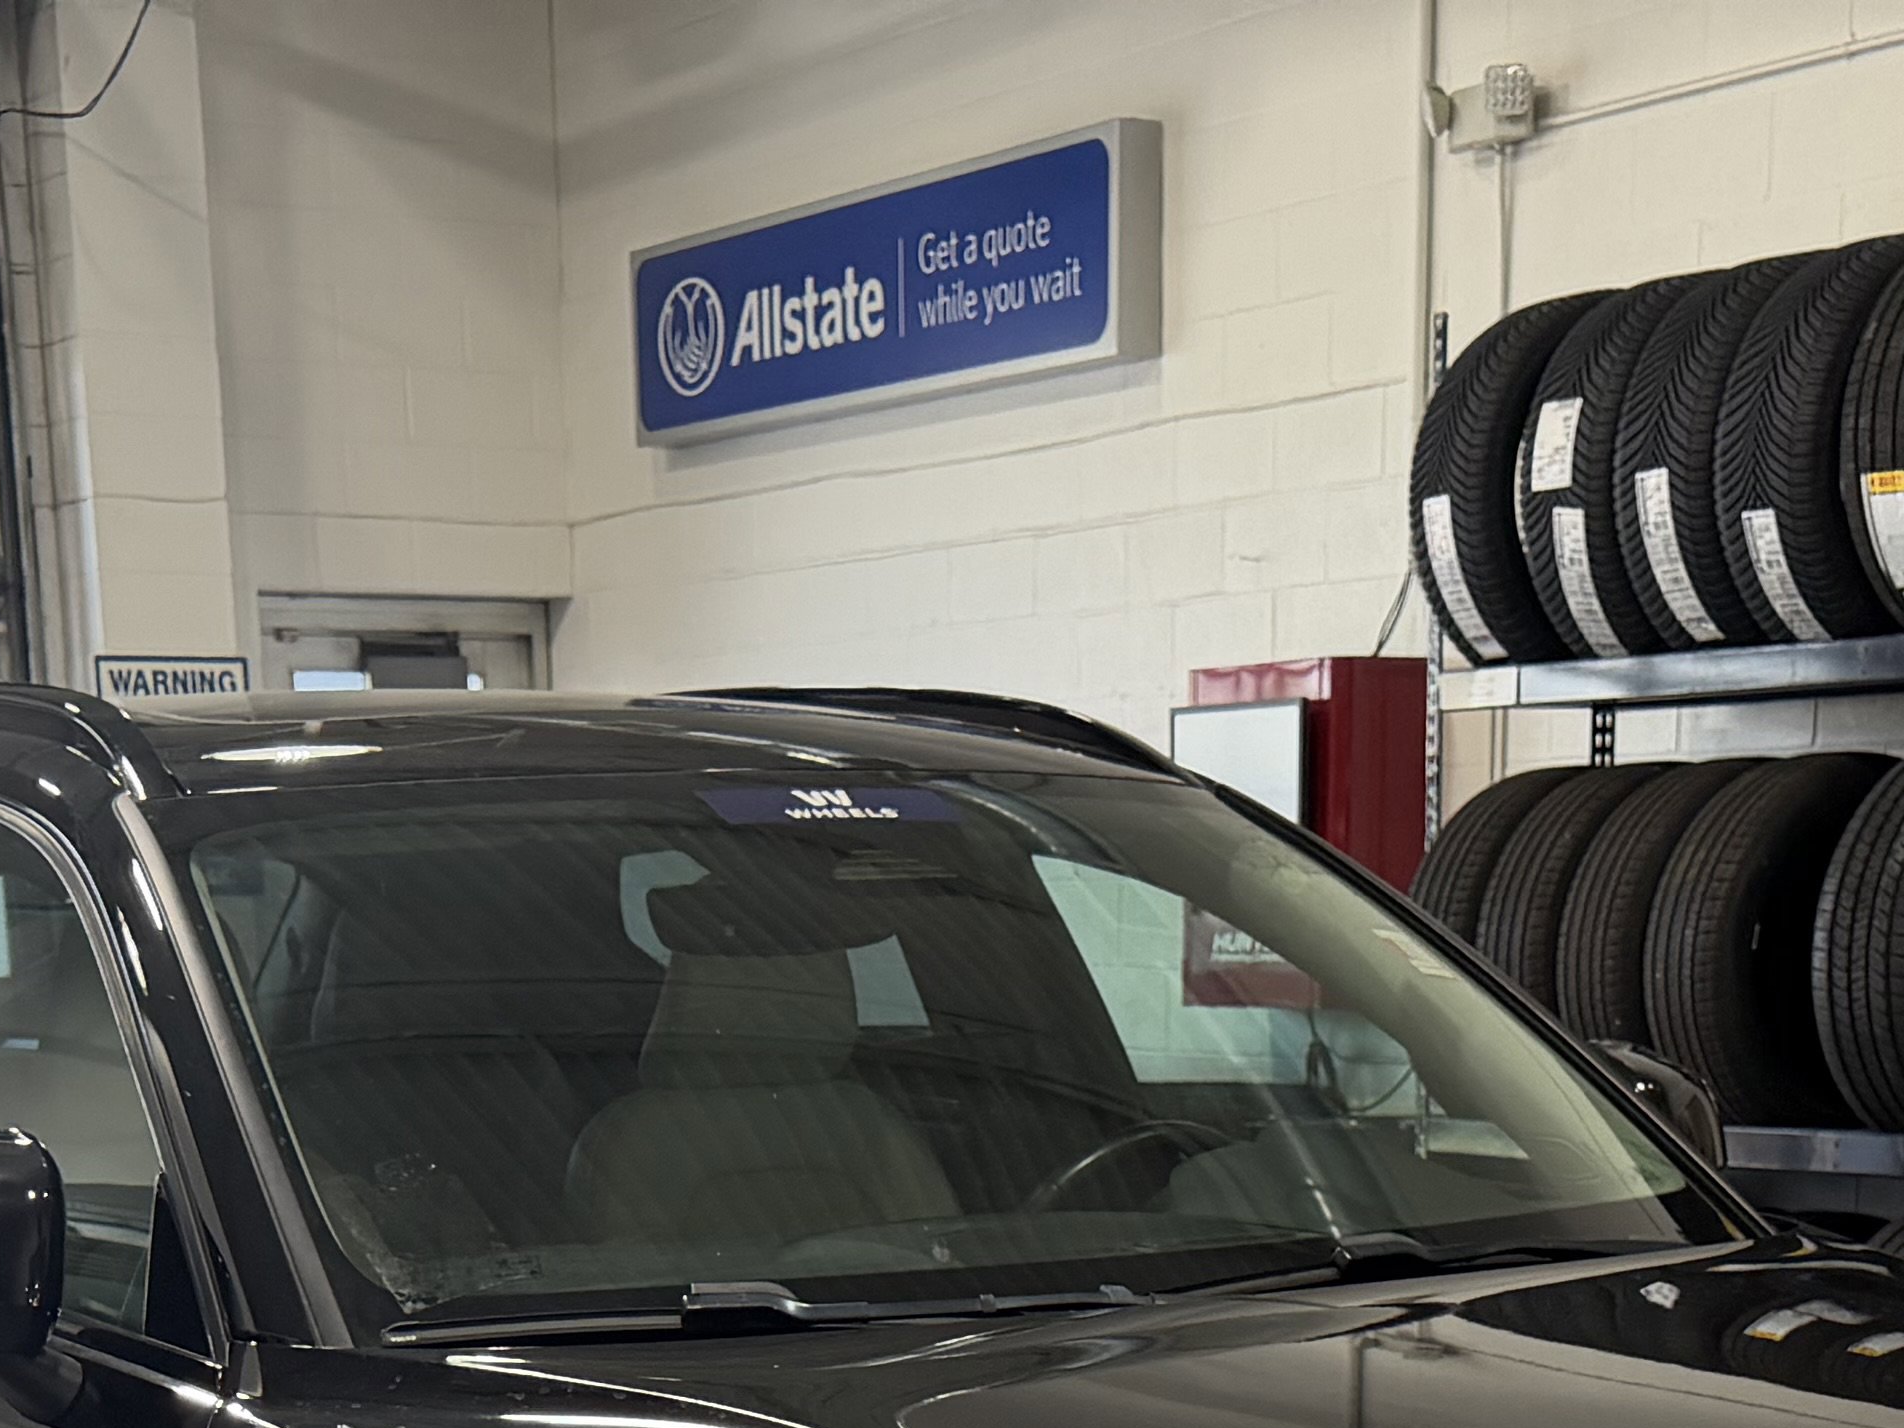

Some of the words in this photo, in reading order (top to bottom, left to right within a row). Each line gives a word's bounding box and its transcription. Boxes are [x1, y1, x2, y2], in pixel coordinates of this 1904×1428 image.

[917, 231, 960, 275] Get
[963, 233, 979, 260] a
[982, 210, 1051, 267] quote
[730, 266, 885, 367] Allstate
[918, 275, 979, 329] while
[982, 278, 1026, 326] you
[1031, 257, 1083, 307] wait
[107, 668, 239, 697] WARNING
[784, 807, 900, 819] WHEELS
